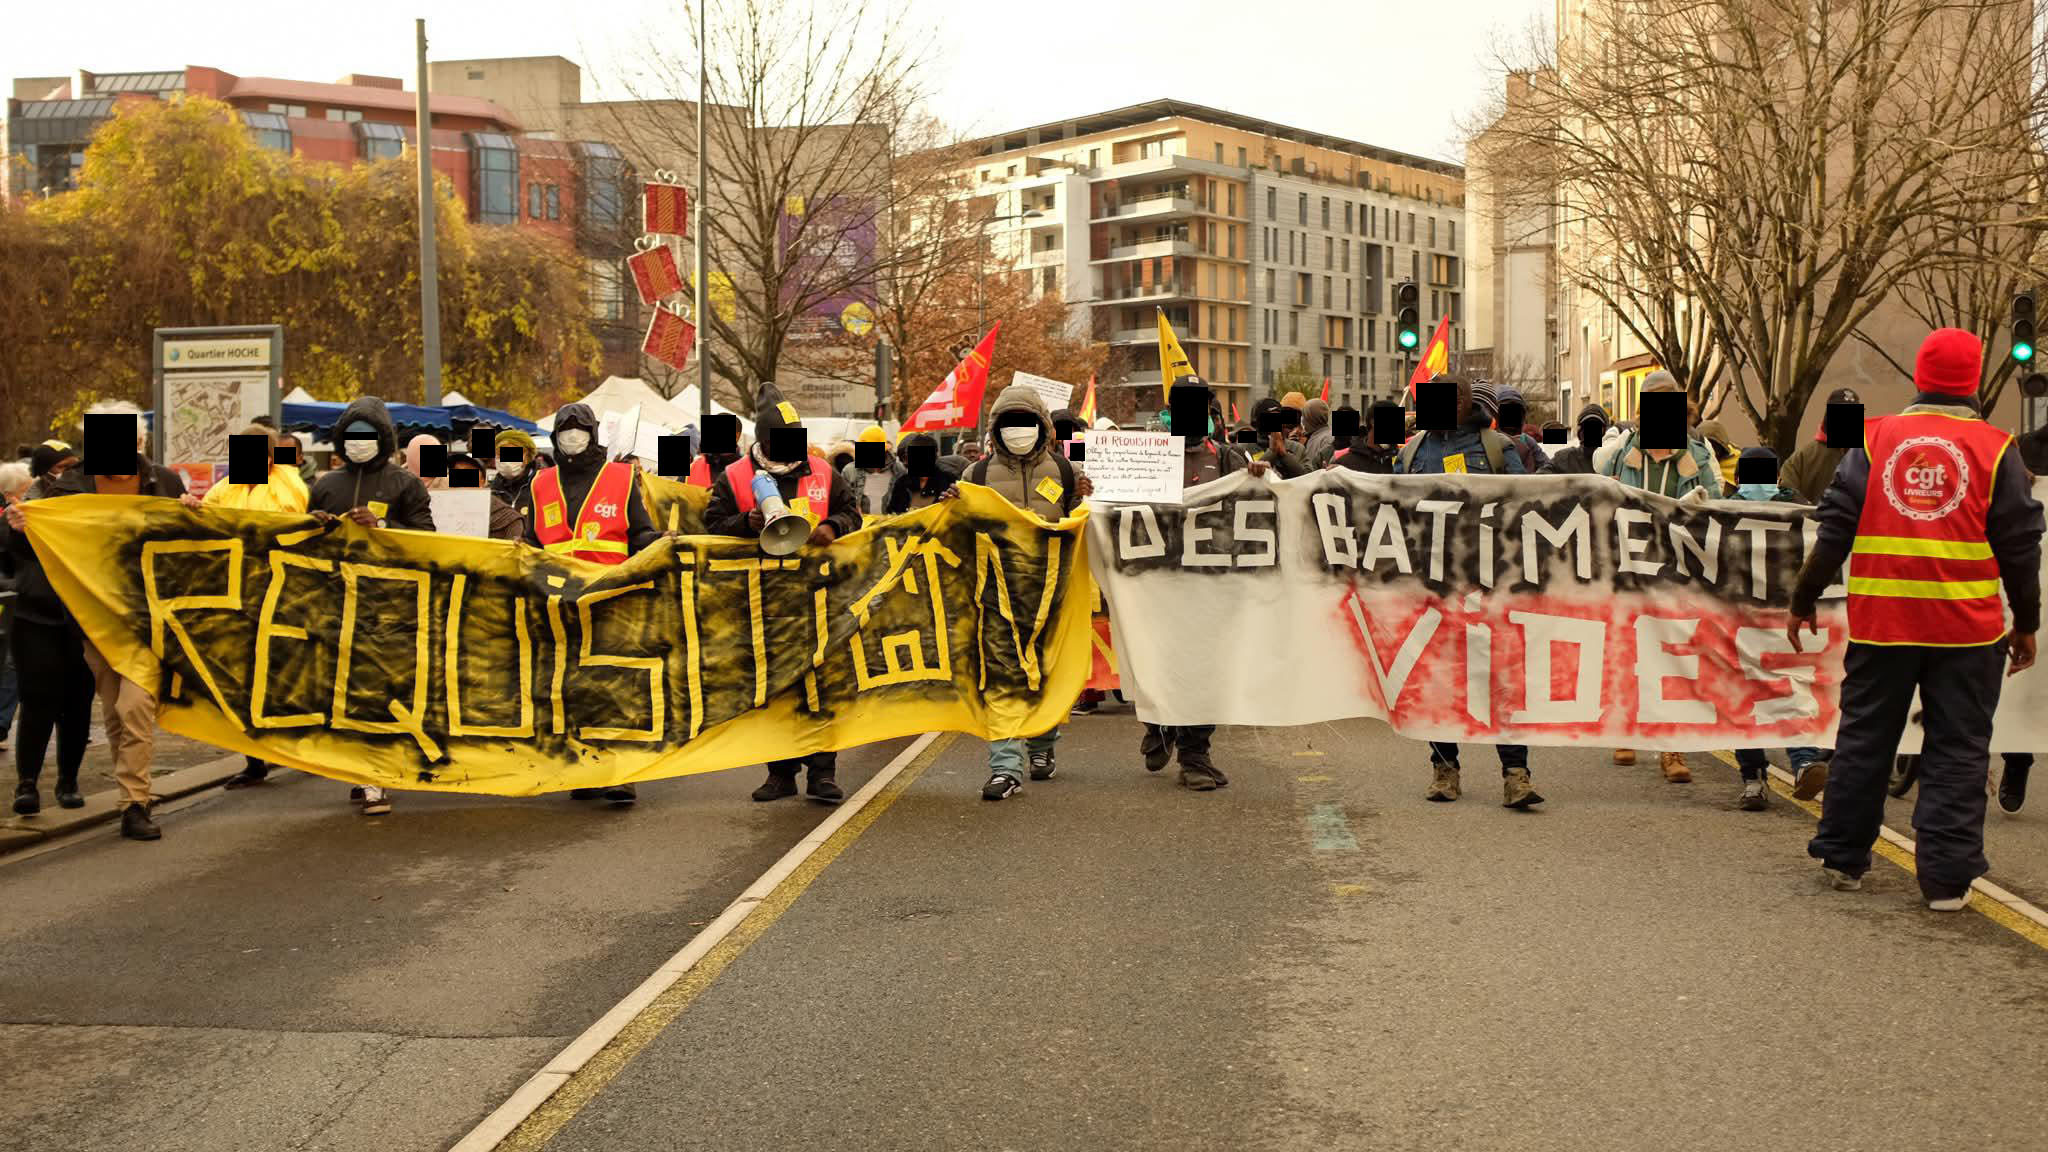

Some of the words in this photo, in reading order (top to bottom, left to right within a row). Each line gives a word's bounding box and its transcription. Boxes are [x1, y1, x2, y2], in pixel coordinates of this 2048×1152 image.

[187, 349, 225, 359] Quartier
[227, 348, 260, 358] HOCHE
[1905, 464, 1945, 490] cgt
[808, 487, 828, 501] cgt
[1904, 488, 1944, 497] LIVREURS
[594, 503, 618, 518] cgt
[1114, 500, 1276, 567] DES
